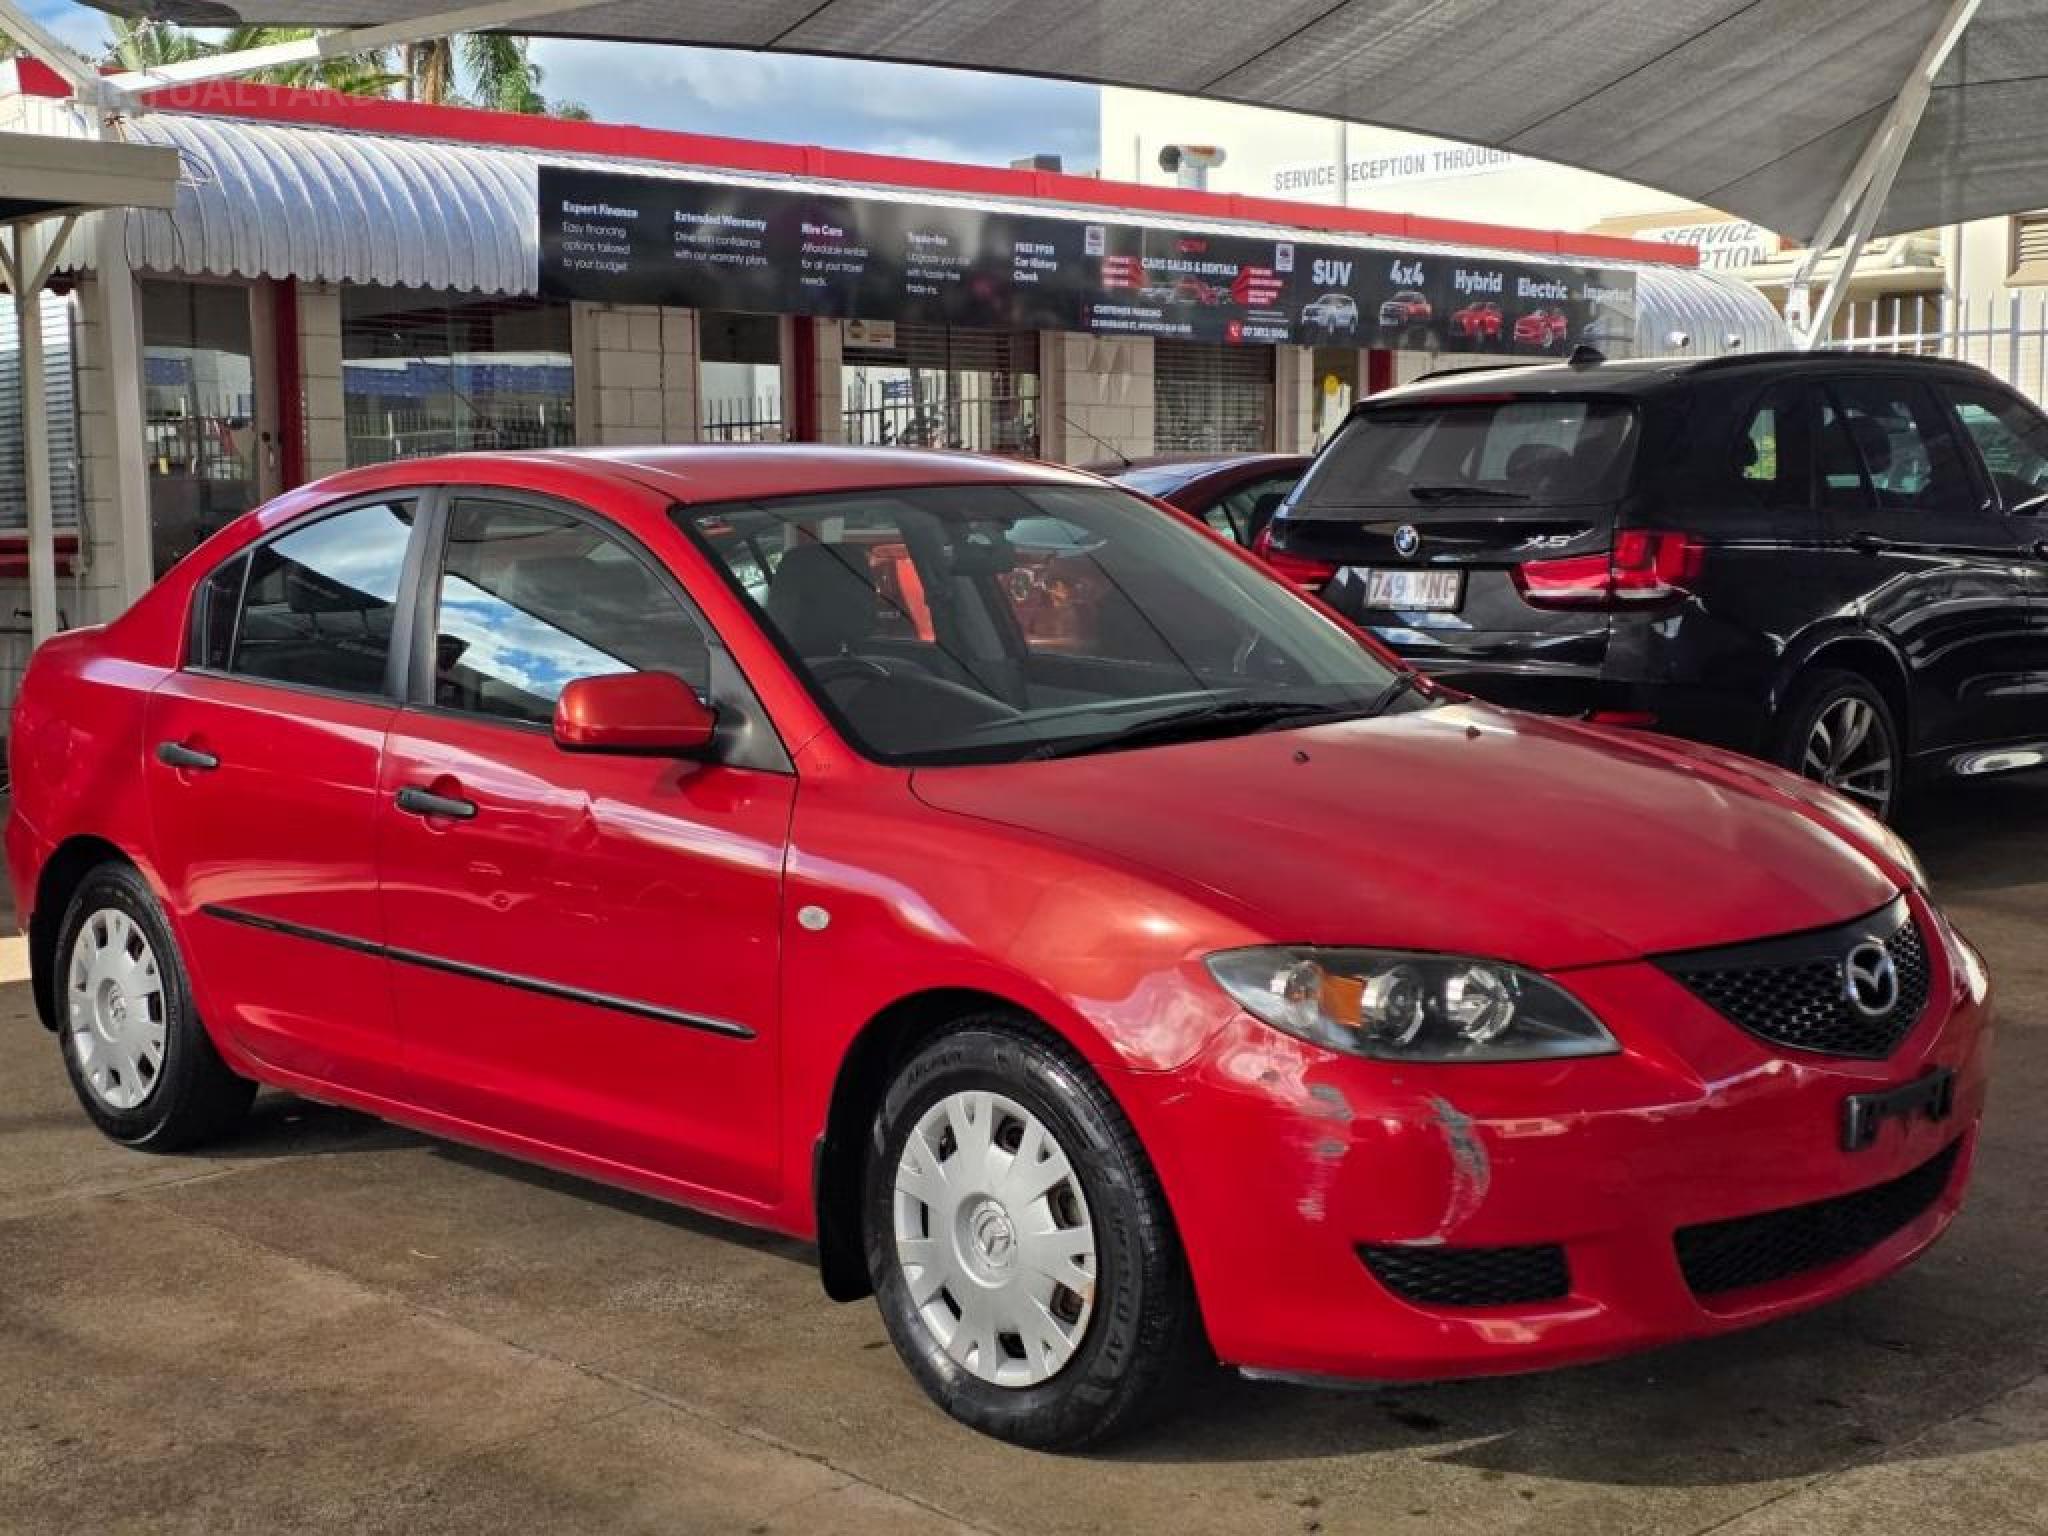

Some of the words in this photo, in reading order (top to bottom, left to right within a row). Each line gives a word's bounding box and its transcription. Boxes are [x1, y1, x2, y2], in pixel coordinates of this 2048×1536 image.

[1275, 165, 1336, 192] SERVICE
[562, 201, 598, 217] Expert
[599, 203, 638, 218] Finance
[1312, 259, 1352, 286] SUV
[1390, 260, 1424, 286] 4x4
[1455, 270, 1503, 293] Hybrid
[1517, 277, 1568, 299] Electric
[1369, 572, 1408, 599] 749
